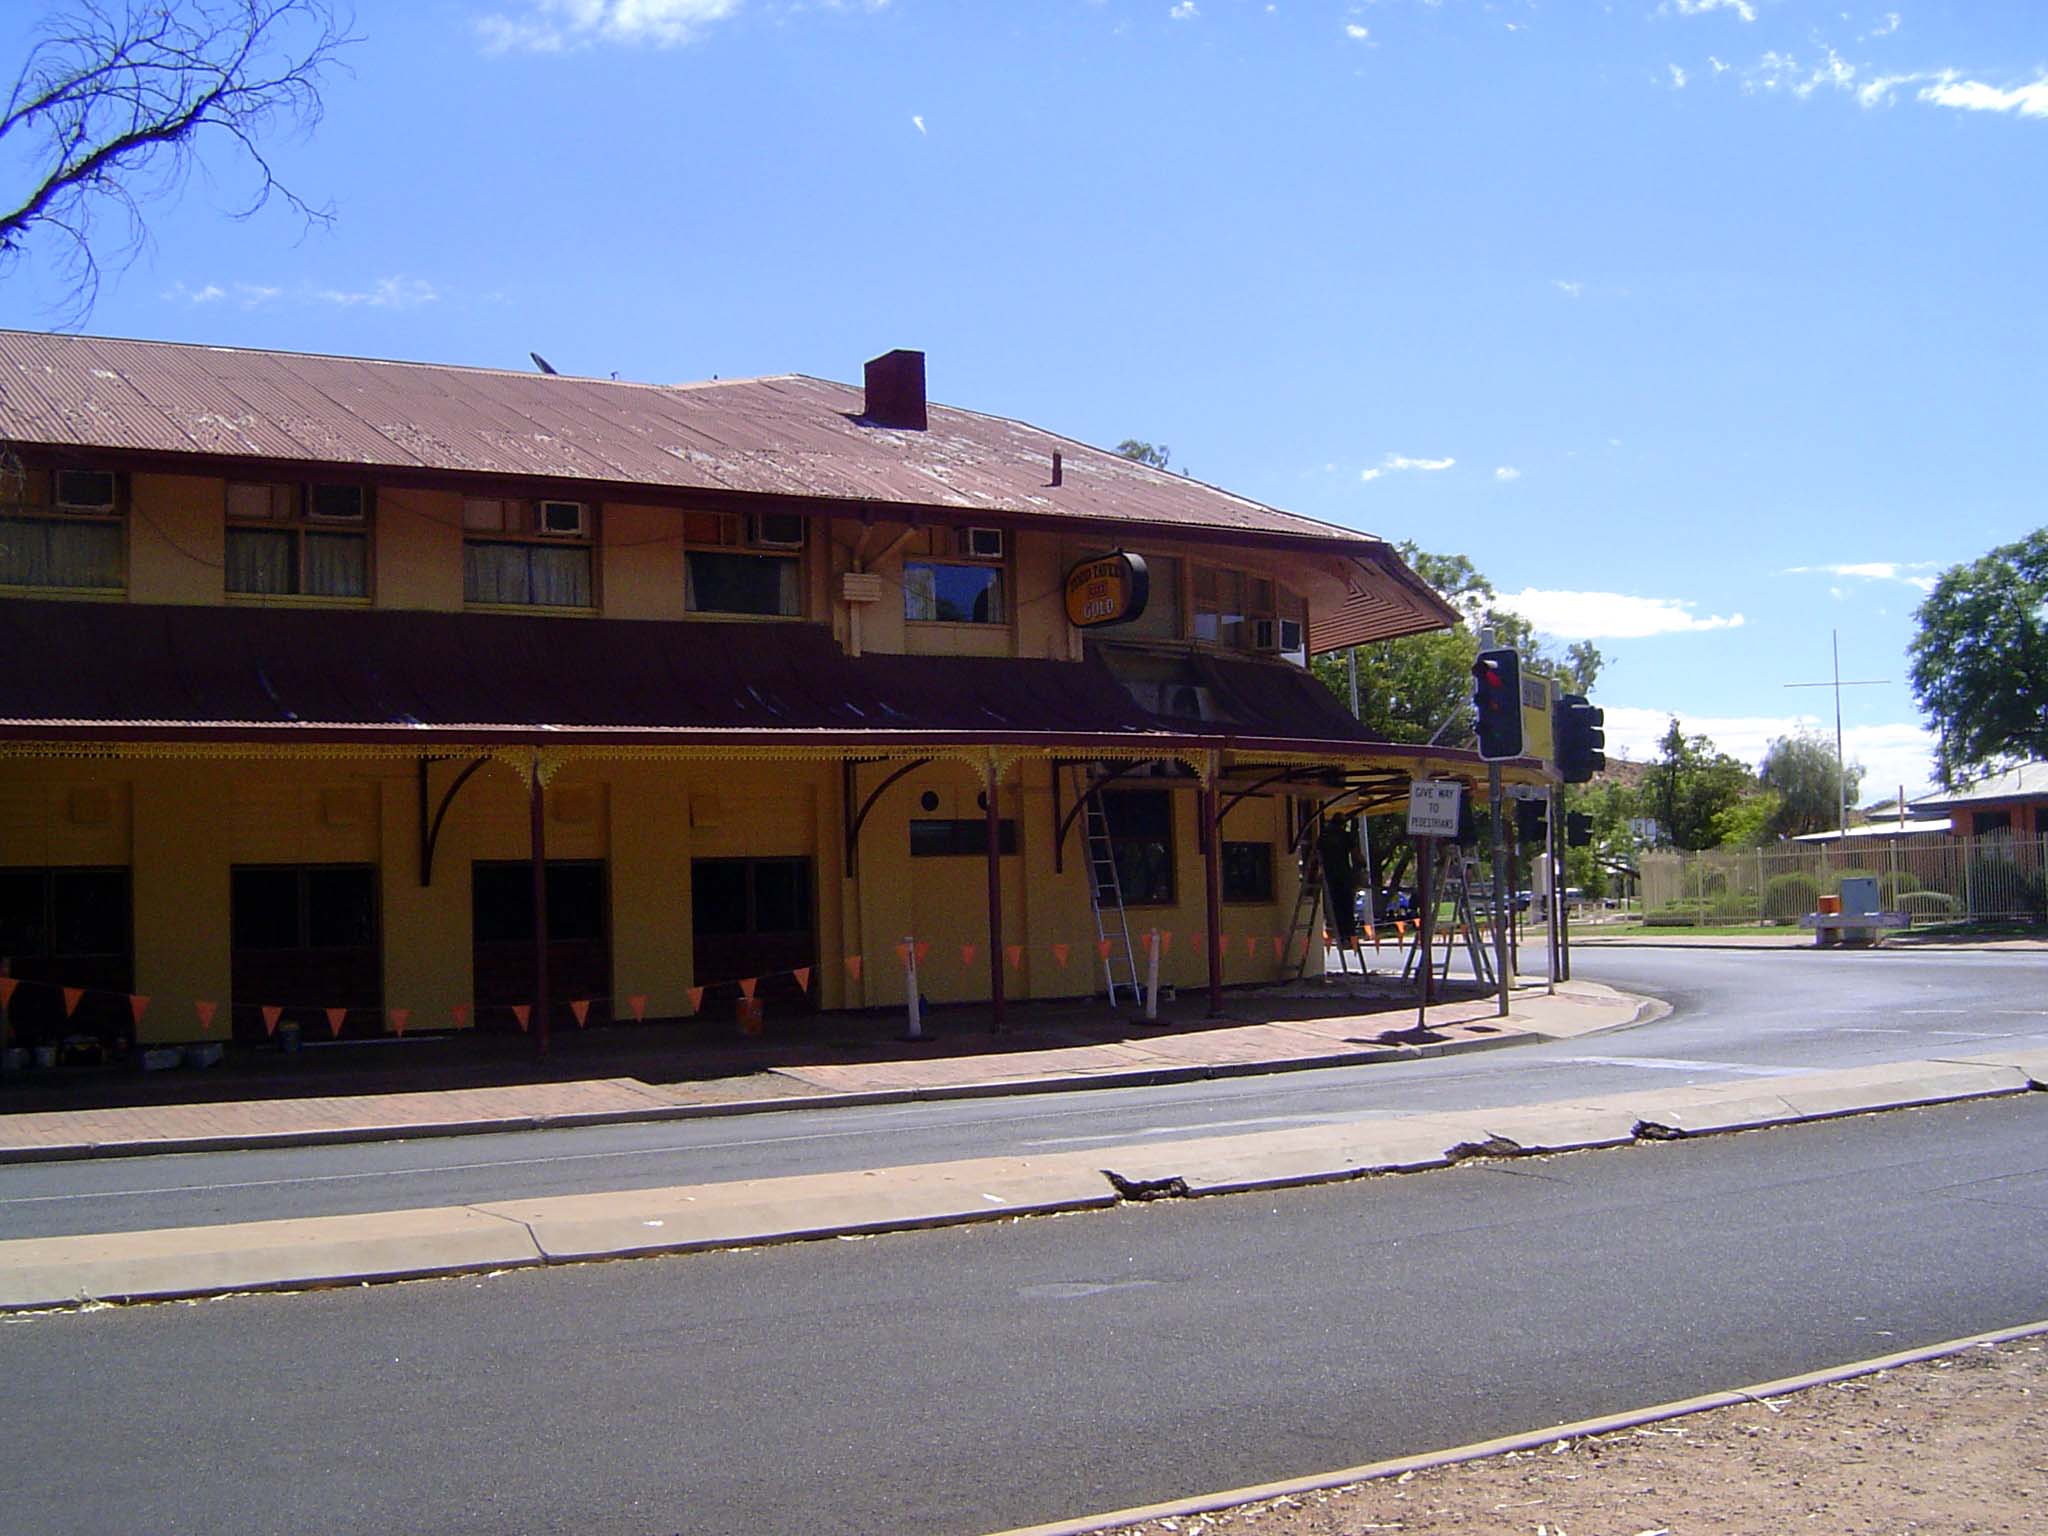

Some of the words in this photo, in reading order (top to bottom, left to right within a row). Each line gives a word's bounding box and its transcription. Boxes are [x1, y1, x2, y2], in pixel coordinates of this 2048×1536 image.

[1083, 598, 1113, 617] GOLD
[1415, 787, 1434, 798] GIVE
[1438, 789, 1454, 799] WAY
[1428, 802, 1439, 814] TO
